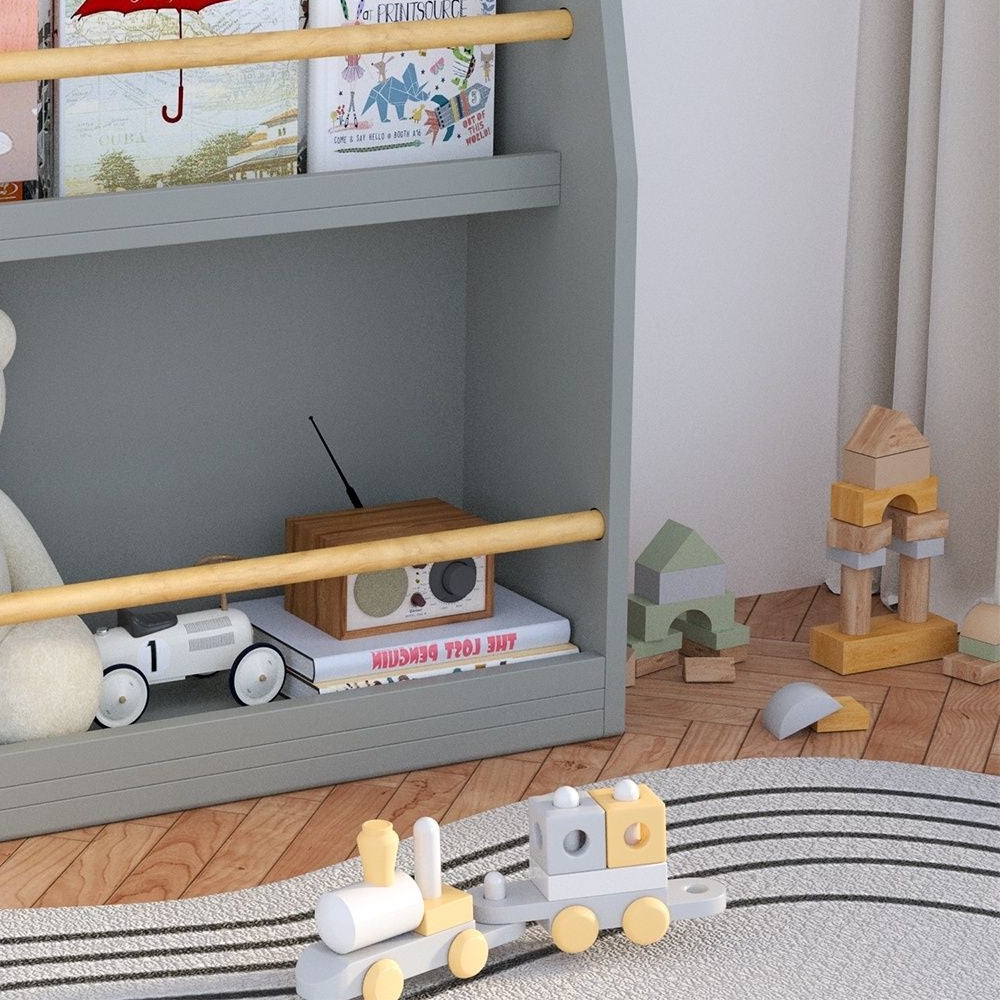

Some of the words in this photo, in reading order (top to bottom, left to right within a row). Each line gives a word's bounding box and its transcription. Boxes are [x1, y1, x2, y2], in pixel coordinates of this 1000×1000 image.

[333, 135, 347, 144] COME
[356, 134, 366, 142] SAY
[369, 132, 385, 141] HELLO
[146, 640, 158, 673] 1
